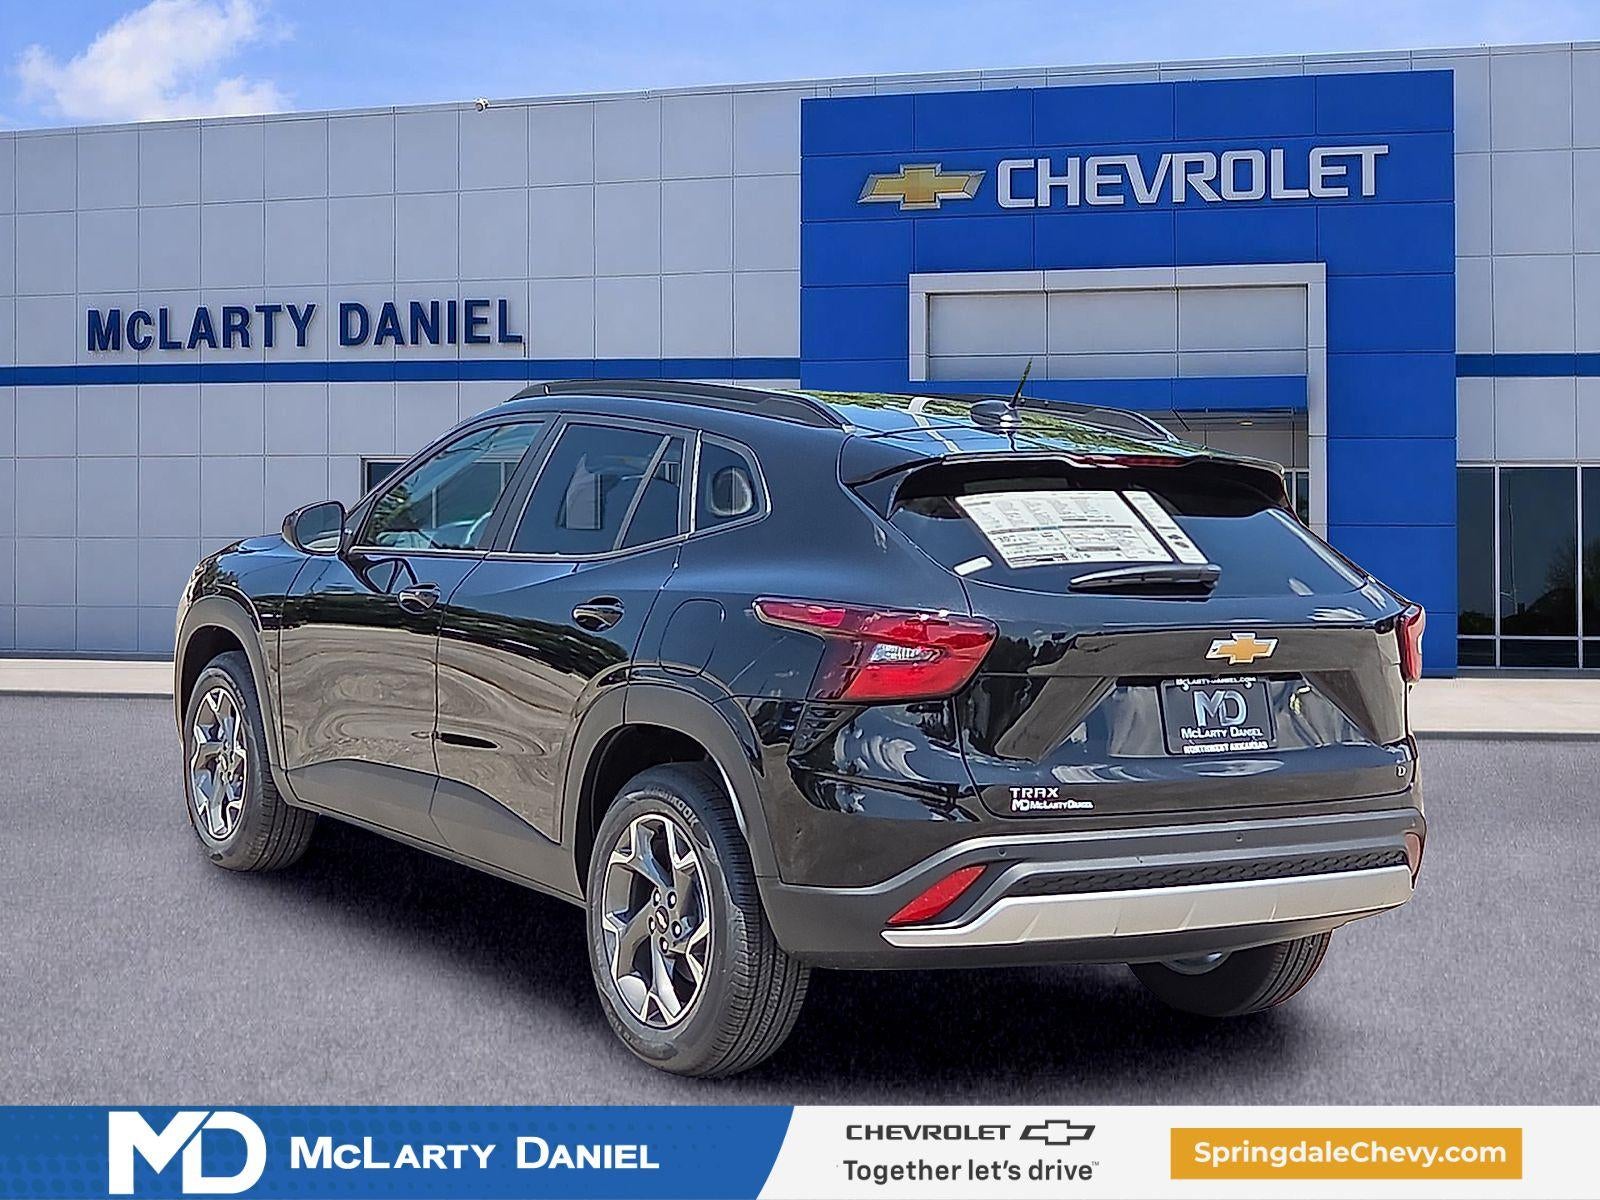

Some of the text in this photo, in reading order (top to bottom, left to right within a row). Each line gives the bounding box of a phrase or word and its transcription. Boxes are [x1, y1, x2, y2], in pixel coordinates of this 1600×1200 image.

[997, 144, 1389, 209] CHEVROLET
[339, 298, 524, 346] DANIEL
[1193, 690, 1248, 727] MD
[1009, 787, 1059, 799] TRAX
